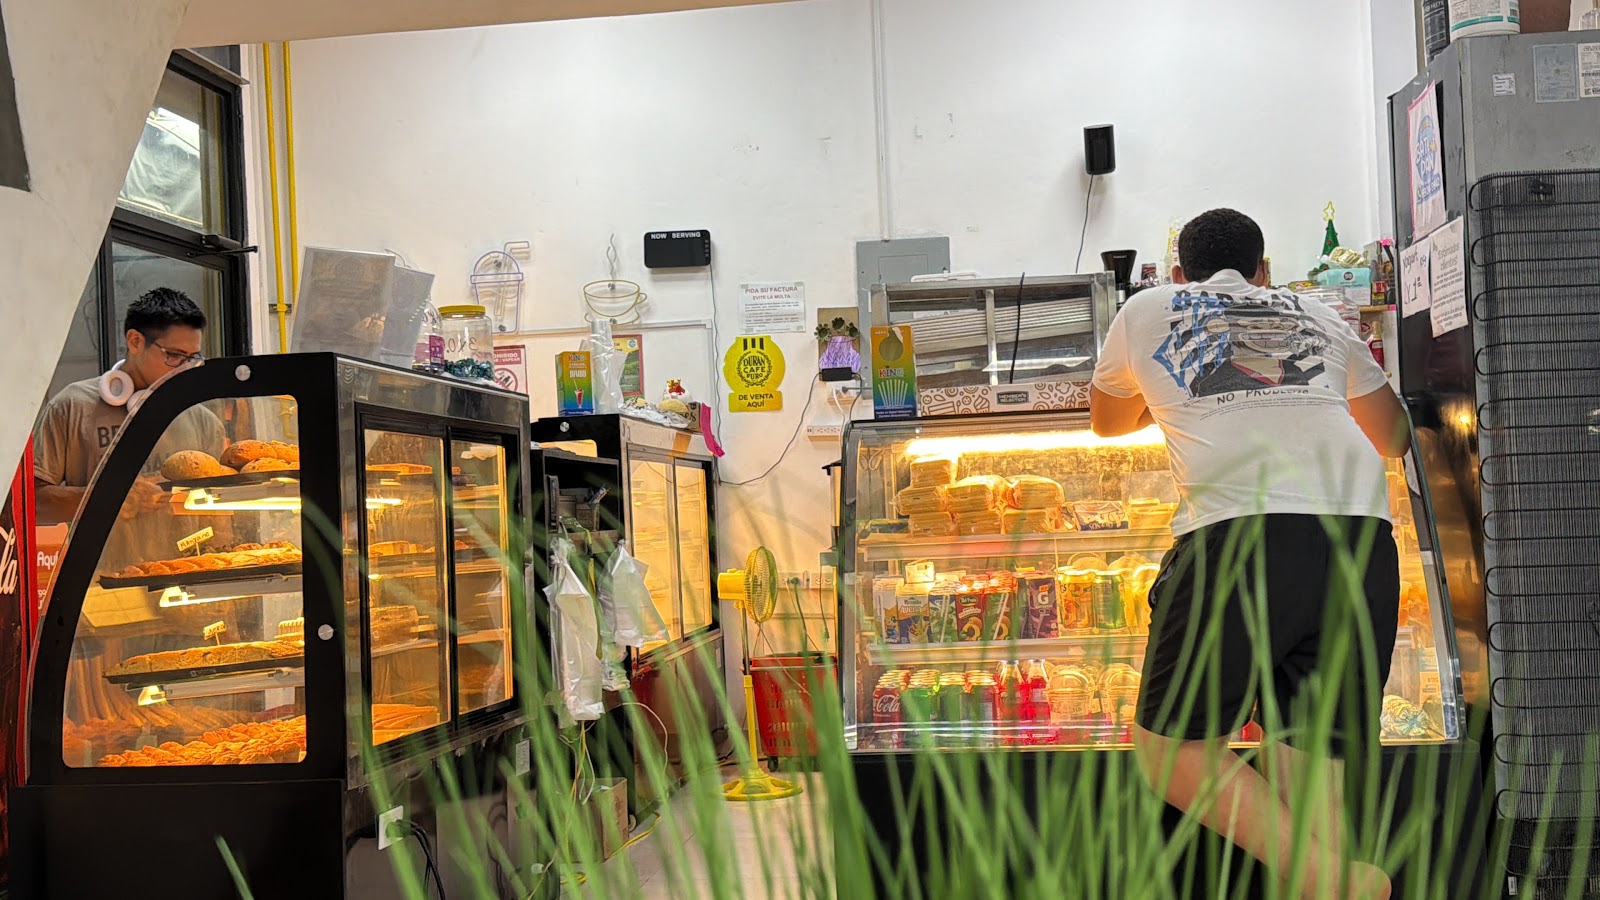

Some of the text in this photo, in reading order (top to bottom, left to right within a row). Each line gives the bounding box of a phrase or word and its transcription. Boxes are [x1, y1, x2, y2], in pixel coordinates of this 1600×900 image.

[671, 231, 701, 239] SERVING
[878, 368, 904, 378] KING
[1216, 392, 1234, 405] NO
[1037, 591, 1050, 604] G
[876, 694, 900, 712] Cola
